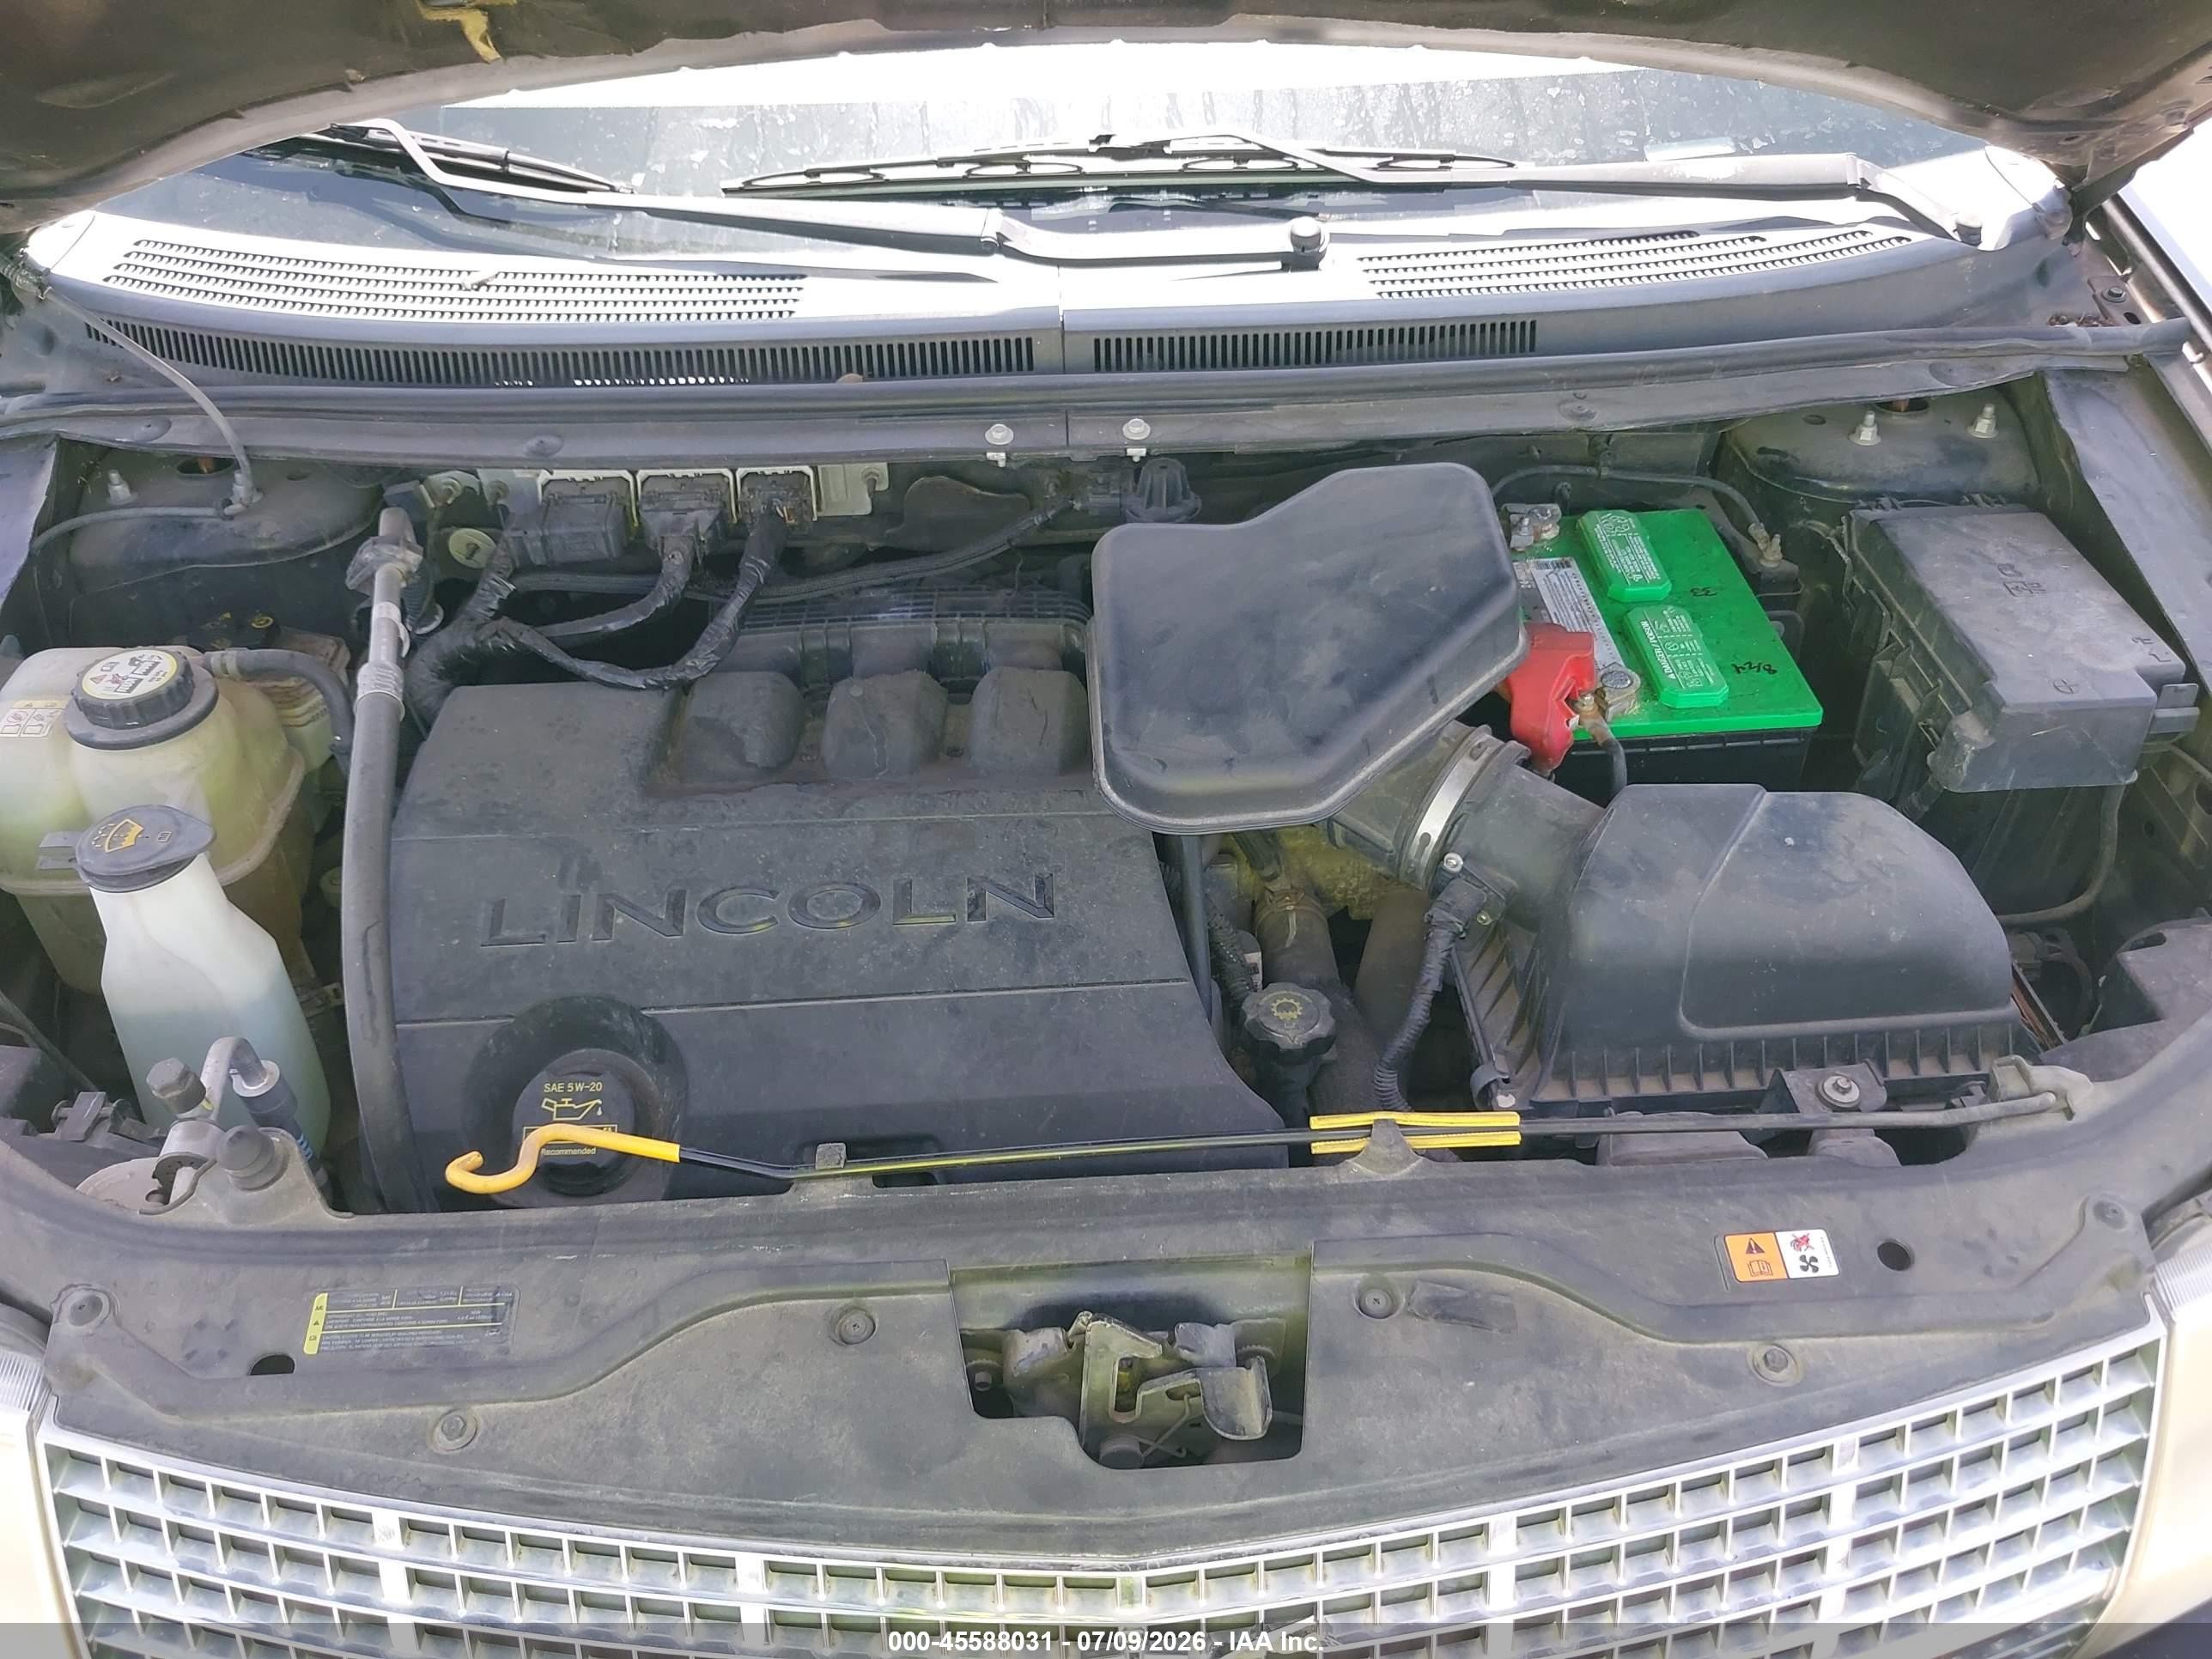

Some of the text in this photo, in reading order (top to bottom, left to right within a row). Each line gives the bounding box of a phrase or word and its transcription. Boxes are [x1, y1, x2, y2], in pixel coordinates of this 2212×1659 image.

[480, 872, 1057, 947] LINCOLN
[544, 1082, 603, 1092] SAE 5W-20
[542, 1147, 596, 1156] Recommended
